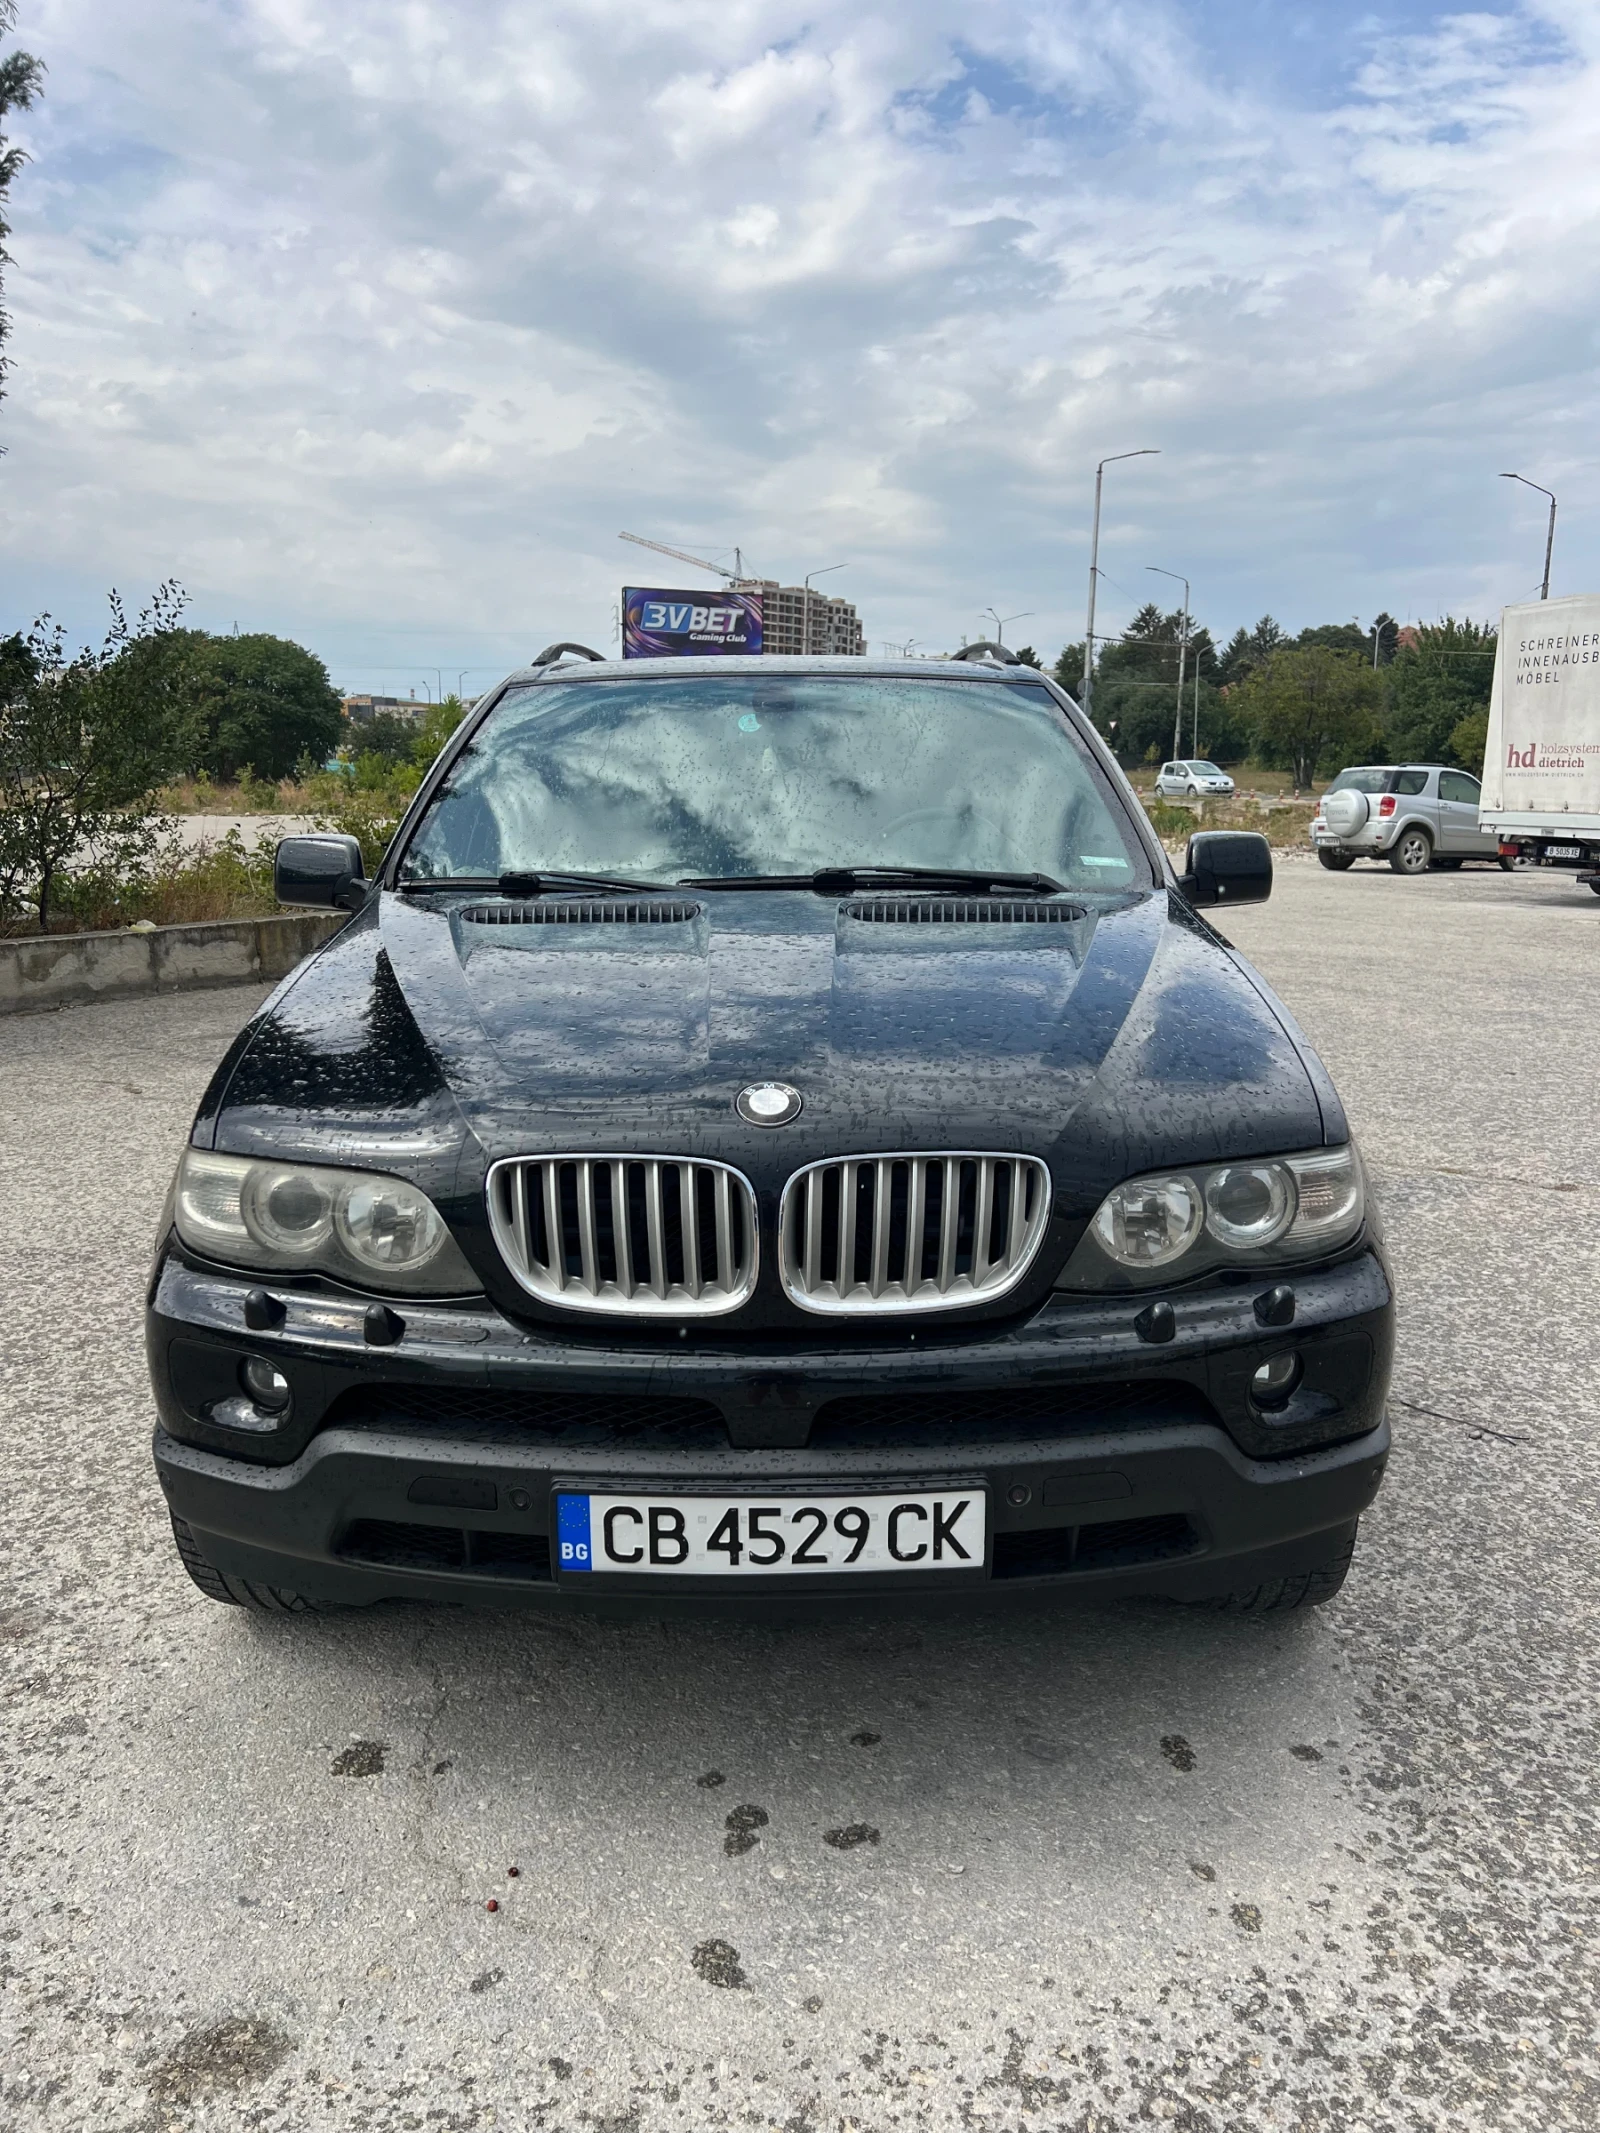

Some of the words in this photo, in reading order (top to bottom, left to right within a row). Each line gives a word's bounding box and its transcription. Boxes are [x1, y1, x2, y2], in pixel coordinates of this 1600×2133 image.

[644, 604, 745, 632] 3VBET
[689, 633, 725, 643] Gaming
[726, 634, 747, 642] Club
[1520, 633, 1600, 652] SCHREINER
[1518, 651, 1600, 668] INNENAUSB
[1516, 671, 1559, 685] MÖBEL
[1506, 743, 1536, 768] hd
[1538, 757, 1585, 768] dietrich
[744, 1083, 795, 1096] BMW
[603, 1506, 689, 1565] CB
[706, 1506, 870, 1565] 4529
[887, 1500, 972, 1562] CK
[561, 1542, 588, 1560] BG
